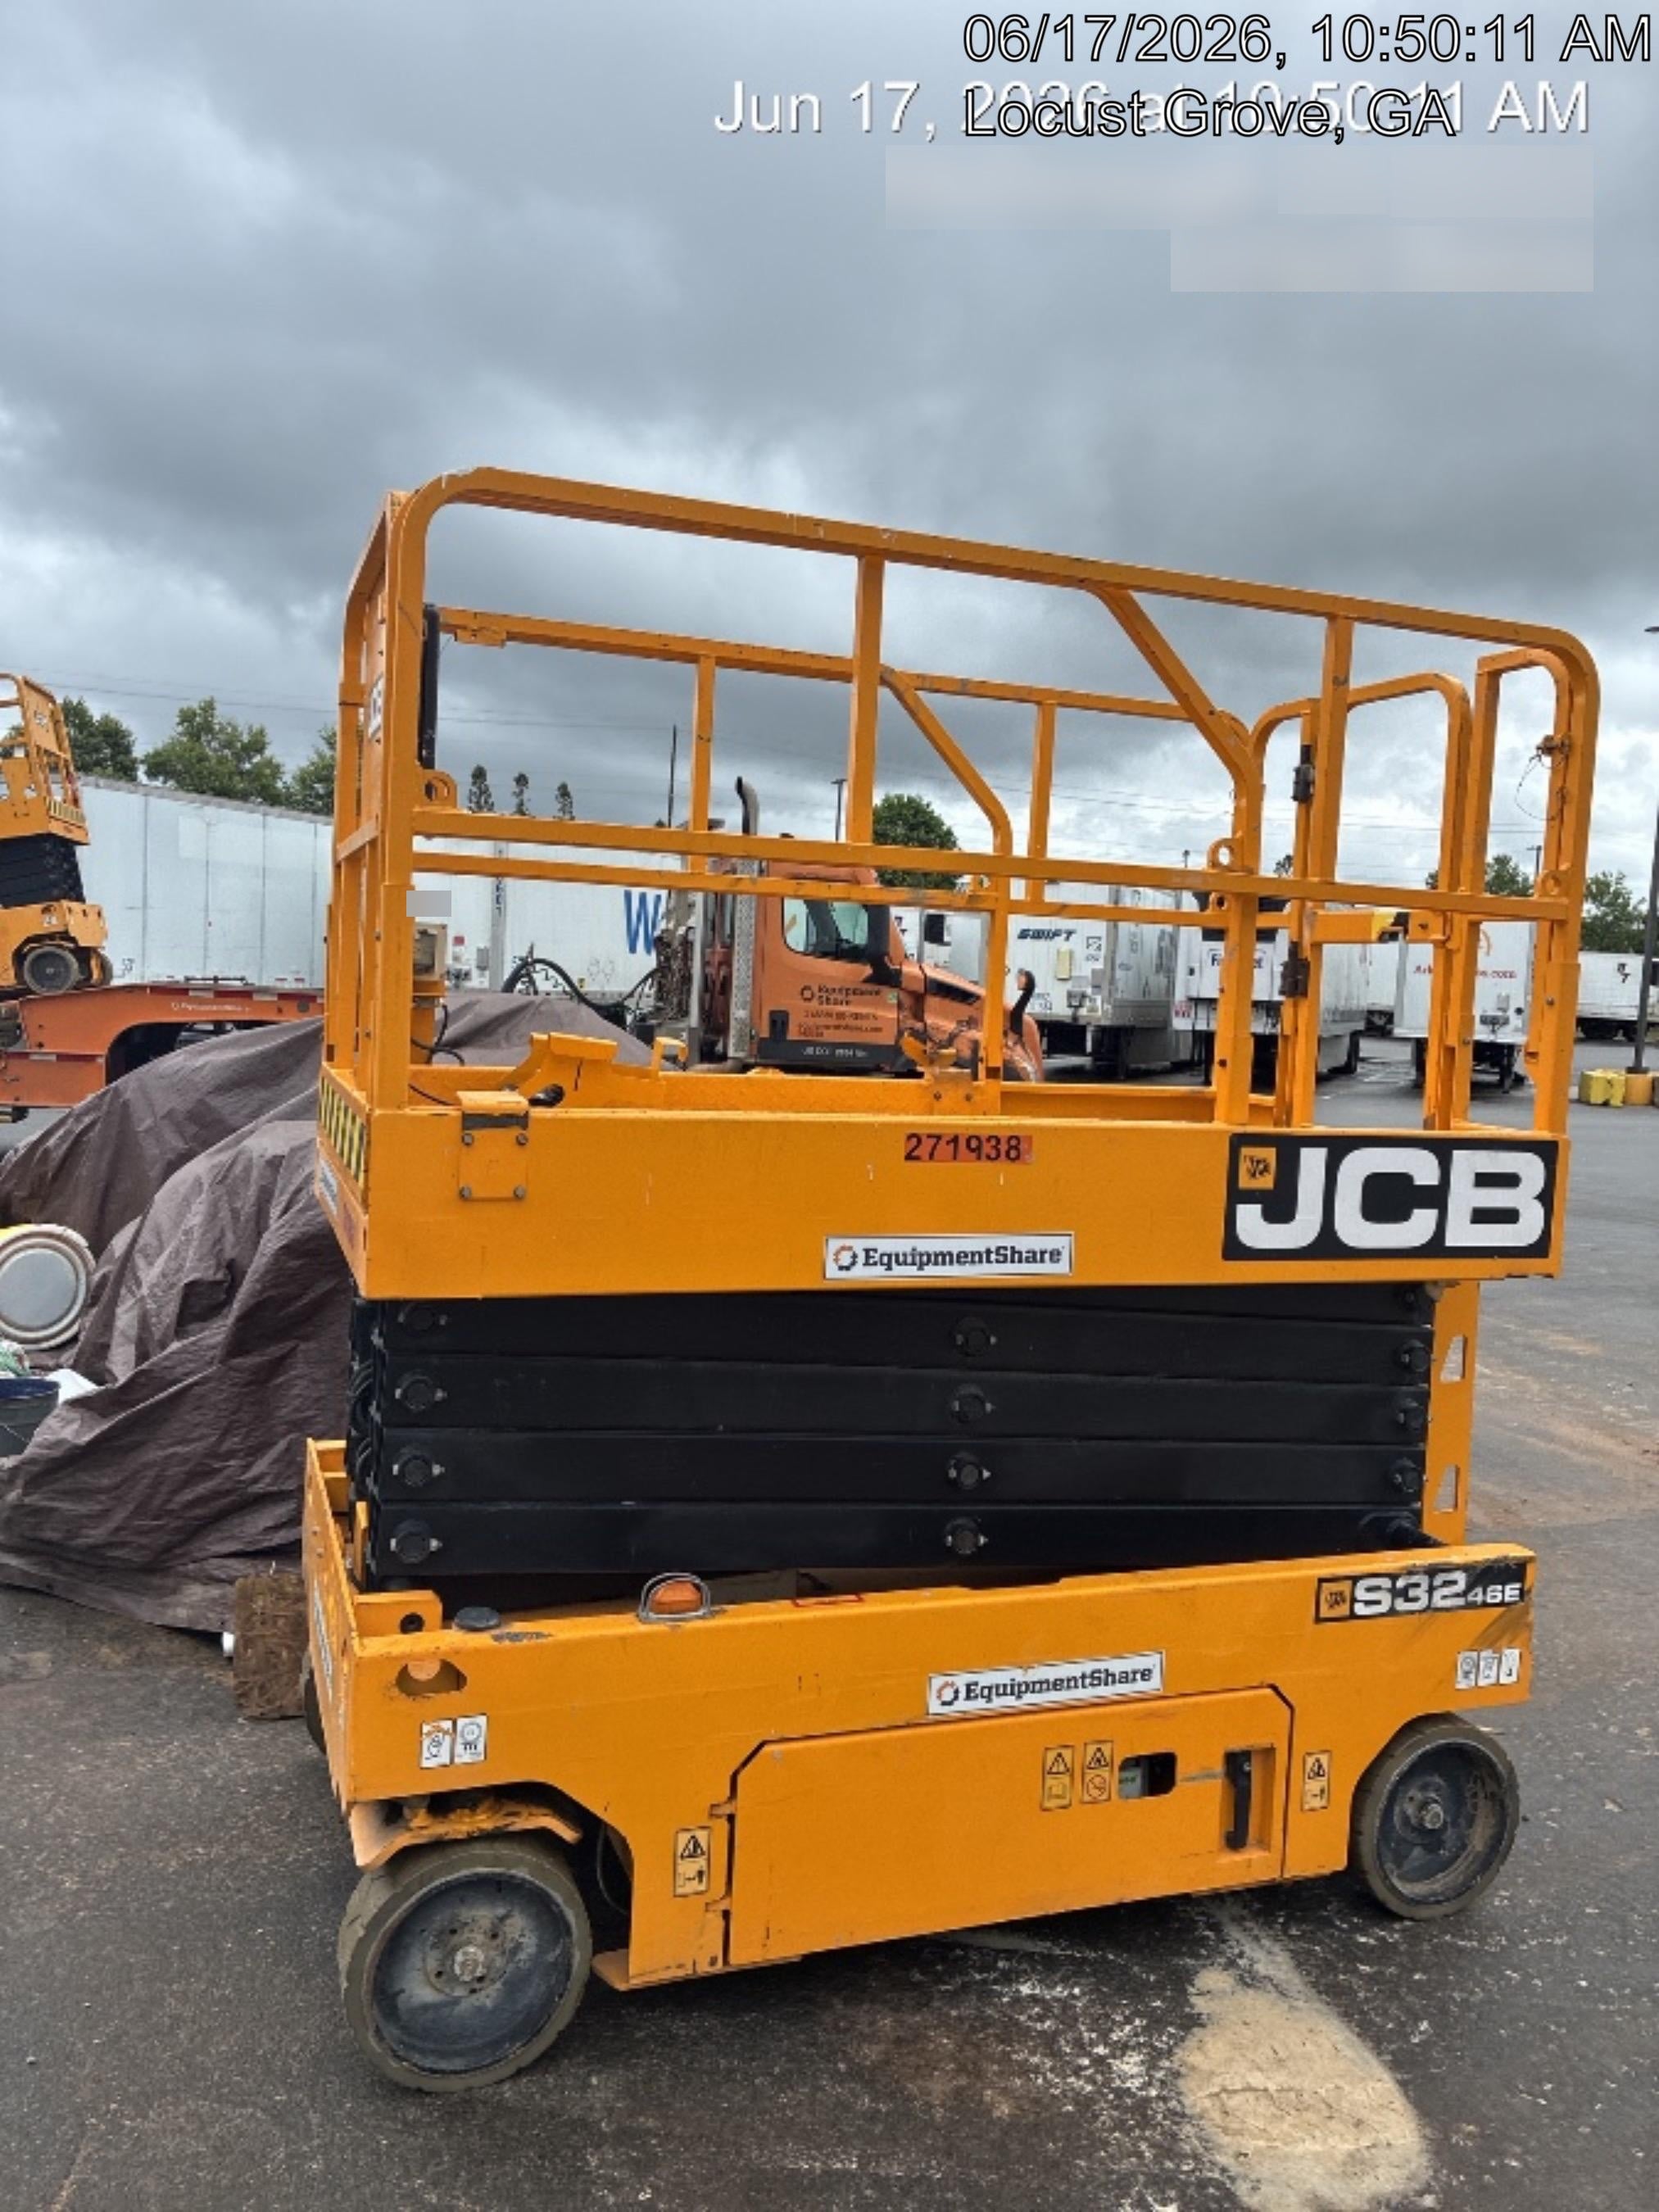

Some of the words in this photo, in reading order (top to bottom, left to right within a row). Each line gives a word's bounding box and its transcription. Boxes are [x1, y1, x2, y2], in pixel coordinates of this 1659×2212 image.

[1018, 928, 1077, 942] SWIFT
[904, 1133, 1022, 1162] 271938
[1235, 1147, 1547, 1249] JCB
[862, 1245, 1063, 1271] EquipmentShare
[963, 1666, 1154, 1703] EquipmentShare
